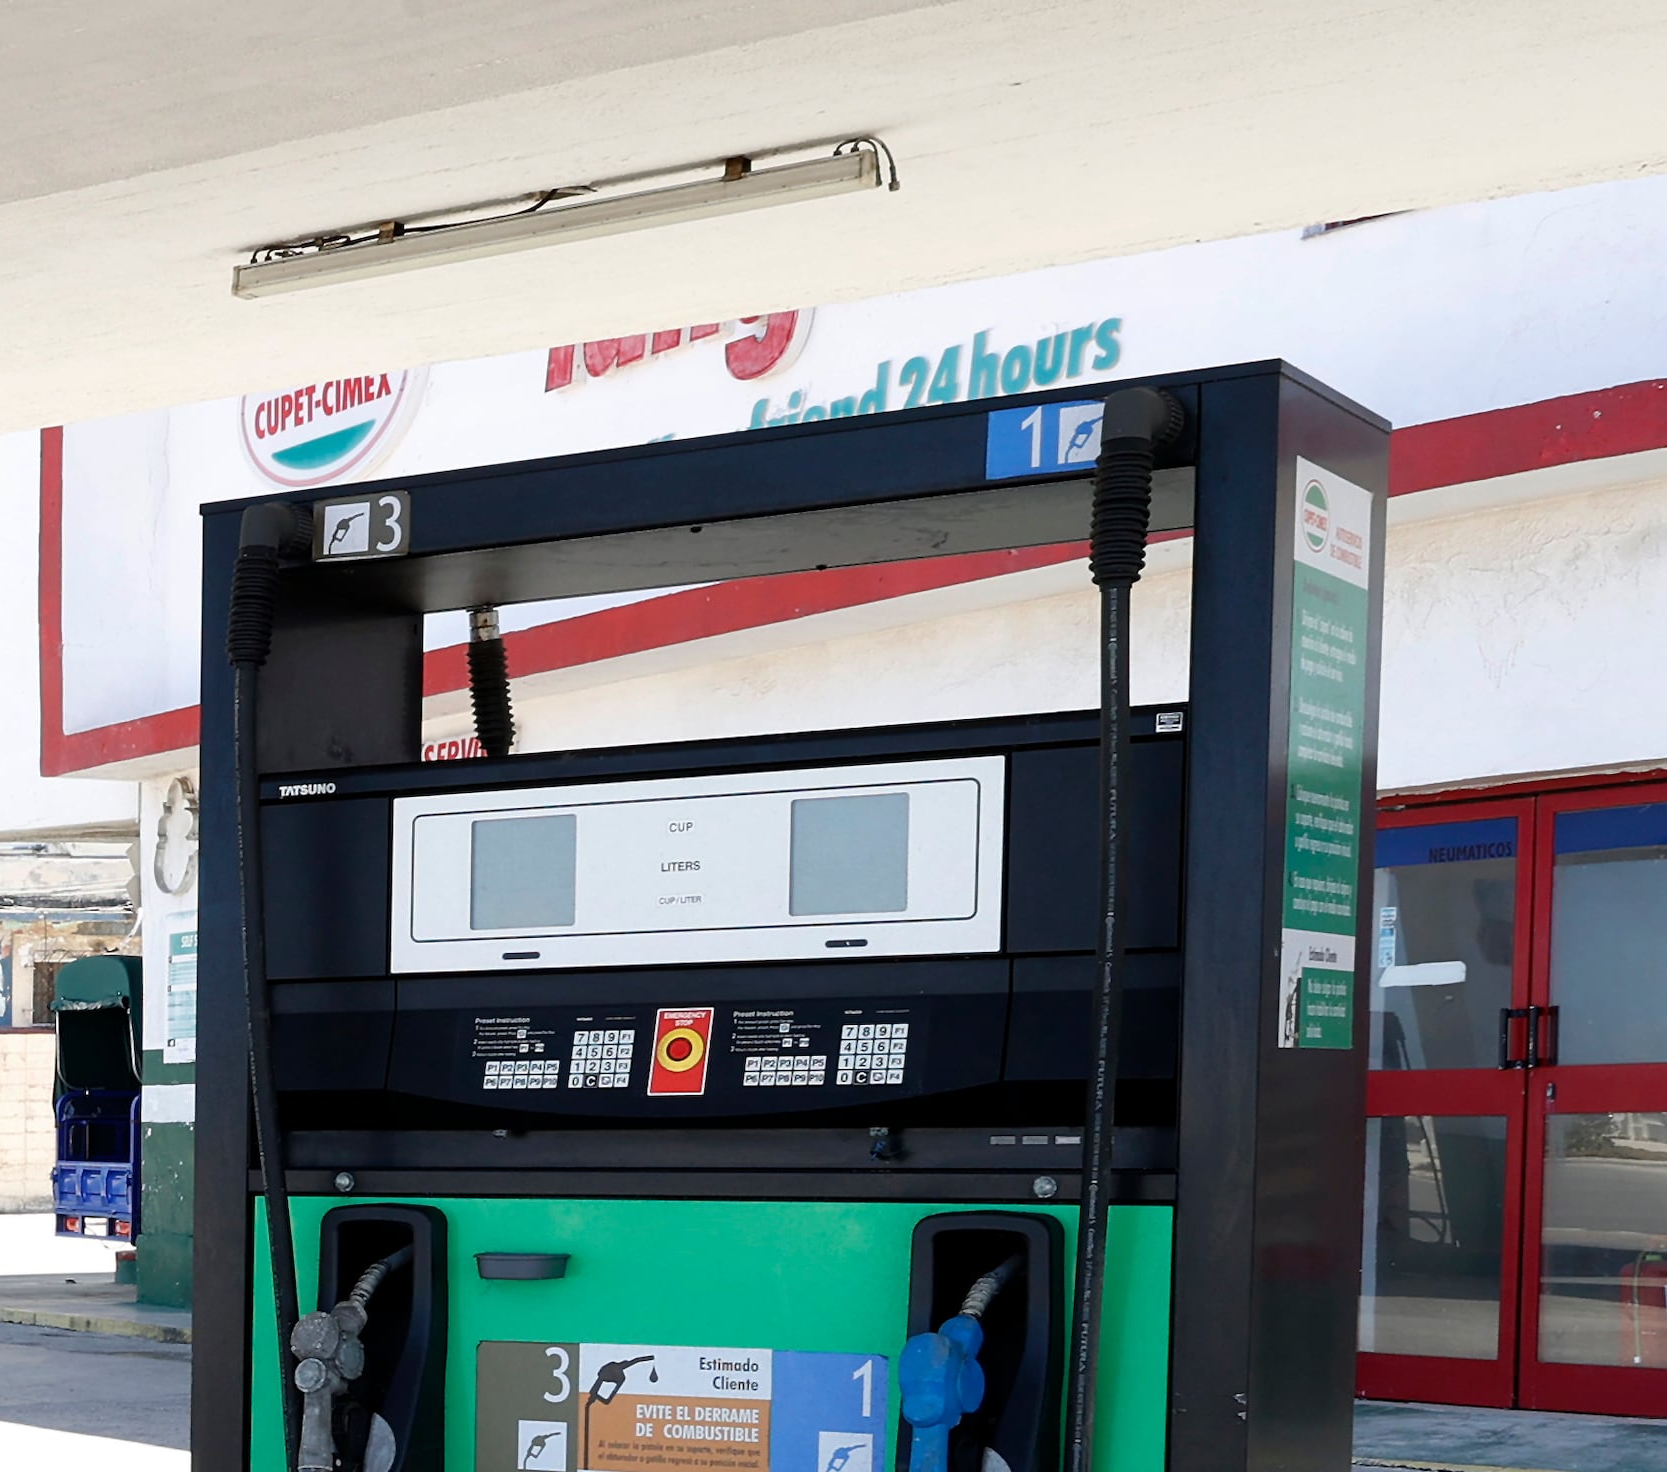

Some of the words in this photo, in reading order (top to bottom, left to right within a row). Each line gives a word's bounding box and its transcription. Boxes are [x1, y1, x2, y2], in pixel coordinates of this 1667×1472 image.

[898, 344, 962, 410] 24
[967, 317, 1122, 400] hours
[254, 373, 392, 440] CUPET-CIMEX
[1020, 405, 1043, 468] 1
[376, 495, 402, 552] 3
[279, 782, 337, 797] TATSUNO
[669, 822, 694, 833] CUP
[661, 860, 701, 872] LITERS
[1429, 841, 1513, 863] NEUMATICOS
[1094, 1060, 1105, 1110] FUTURA
[1078, 1323, 1088, 1372] FUTURA
[543, 1347, 571, 1403] 3
[699, 1357, 759, 1374] Estimado
[713, 1375, 759, 1392] Cliente
[852, 1359, 873, 1418] 1
[636, 1404, 672, 1419] EVITE
[676, 1406, 691, 1420] EL
[694, 1407, 759, 1424] DERRAME
[635, 1423, 653, 1437] DE
[664, 1424, 759, 1443] COMBUSTIBLE
